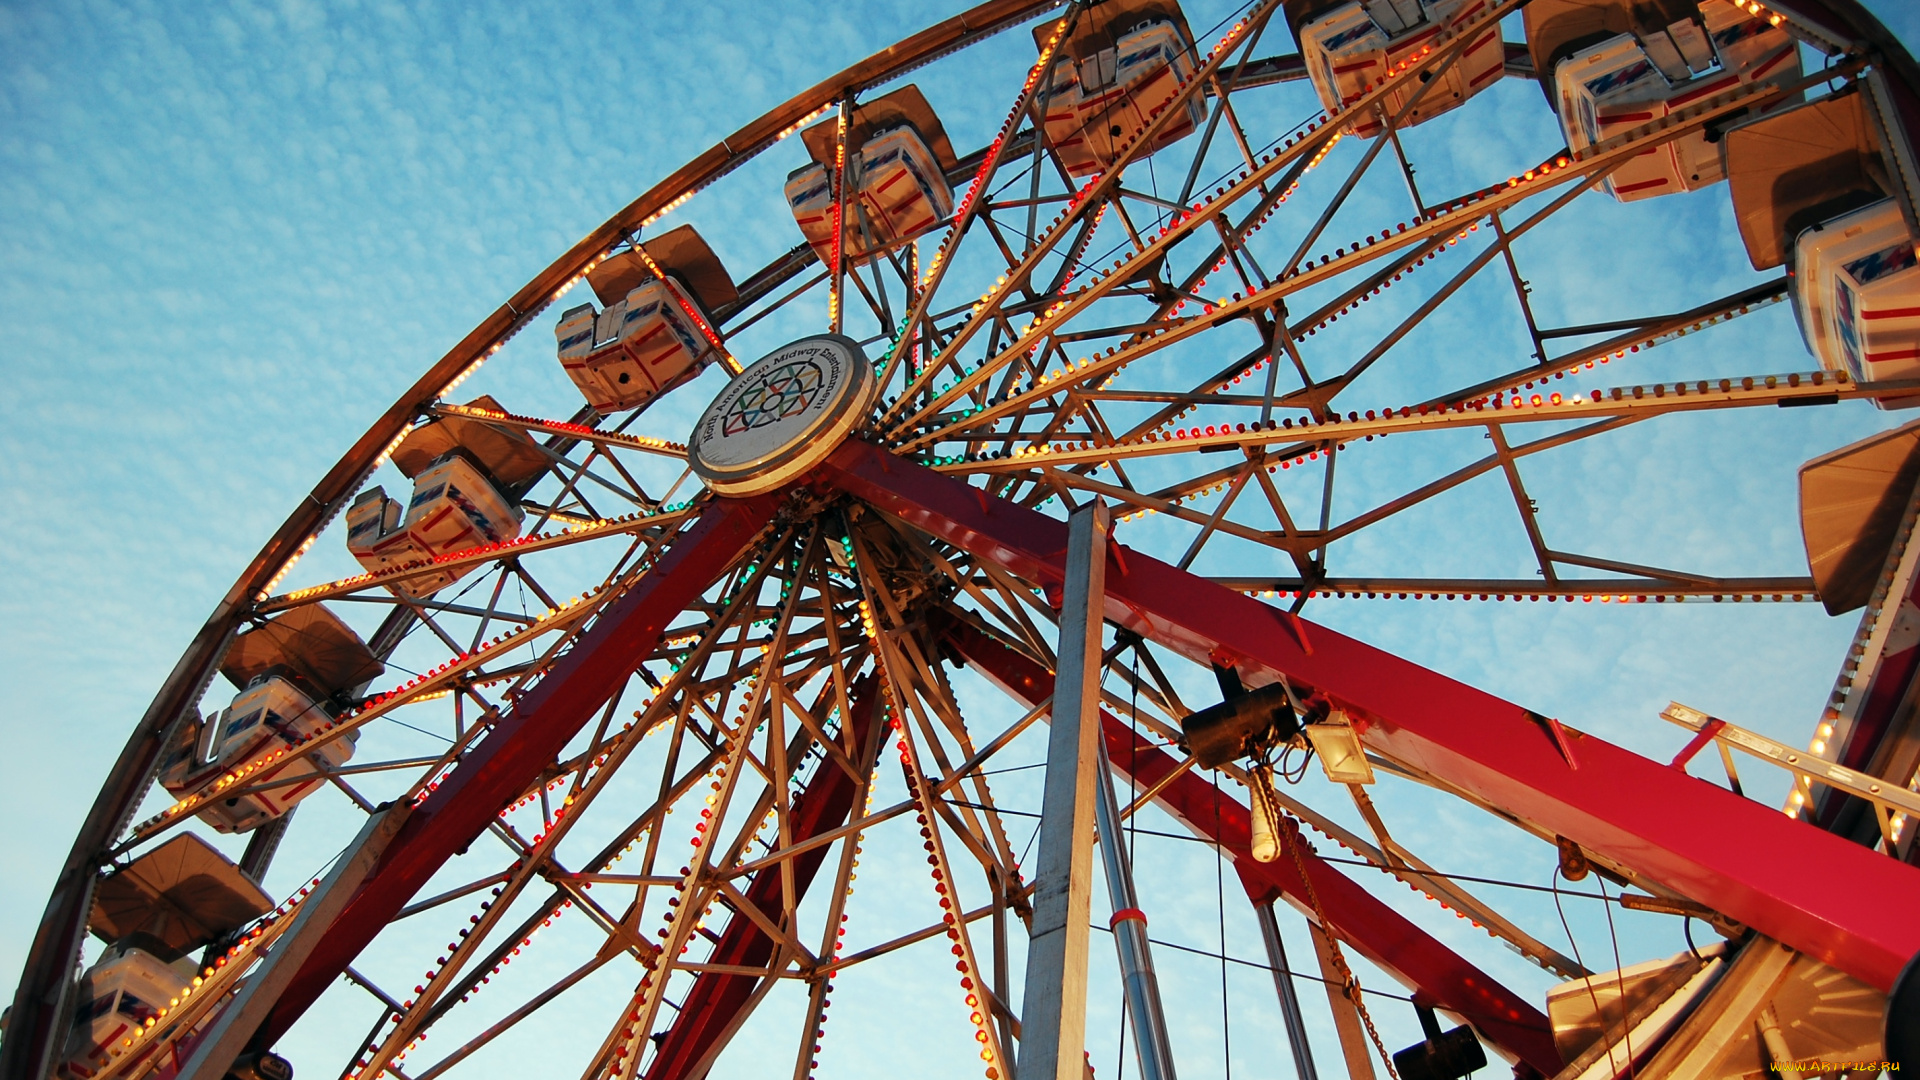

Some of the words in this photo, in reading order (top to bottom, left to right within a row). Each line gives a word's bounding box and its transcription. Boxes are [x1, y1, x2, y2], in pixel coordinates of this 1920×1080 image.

[703, 414, 719, 443] North
[717, 364, 770, 411] American
[773, 347, 821, 365] Midway
[815, 348, 841, 409] Entertainment
